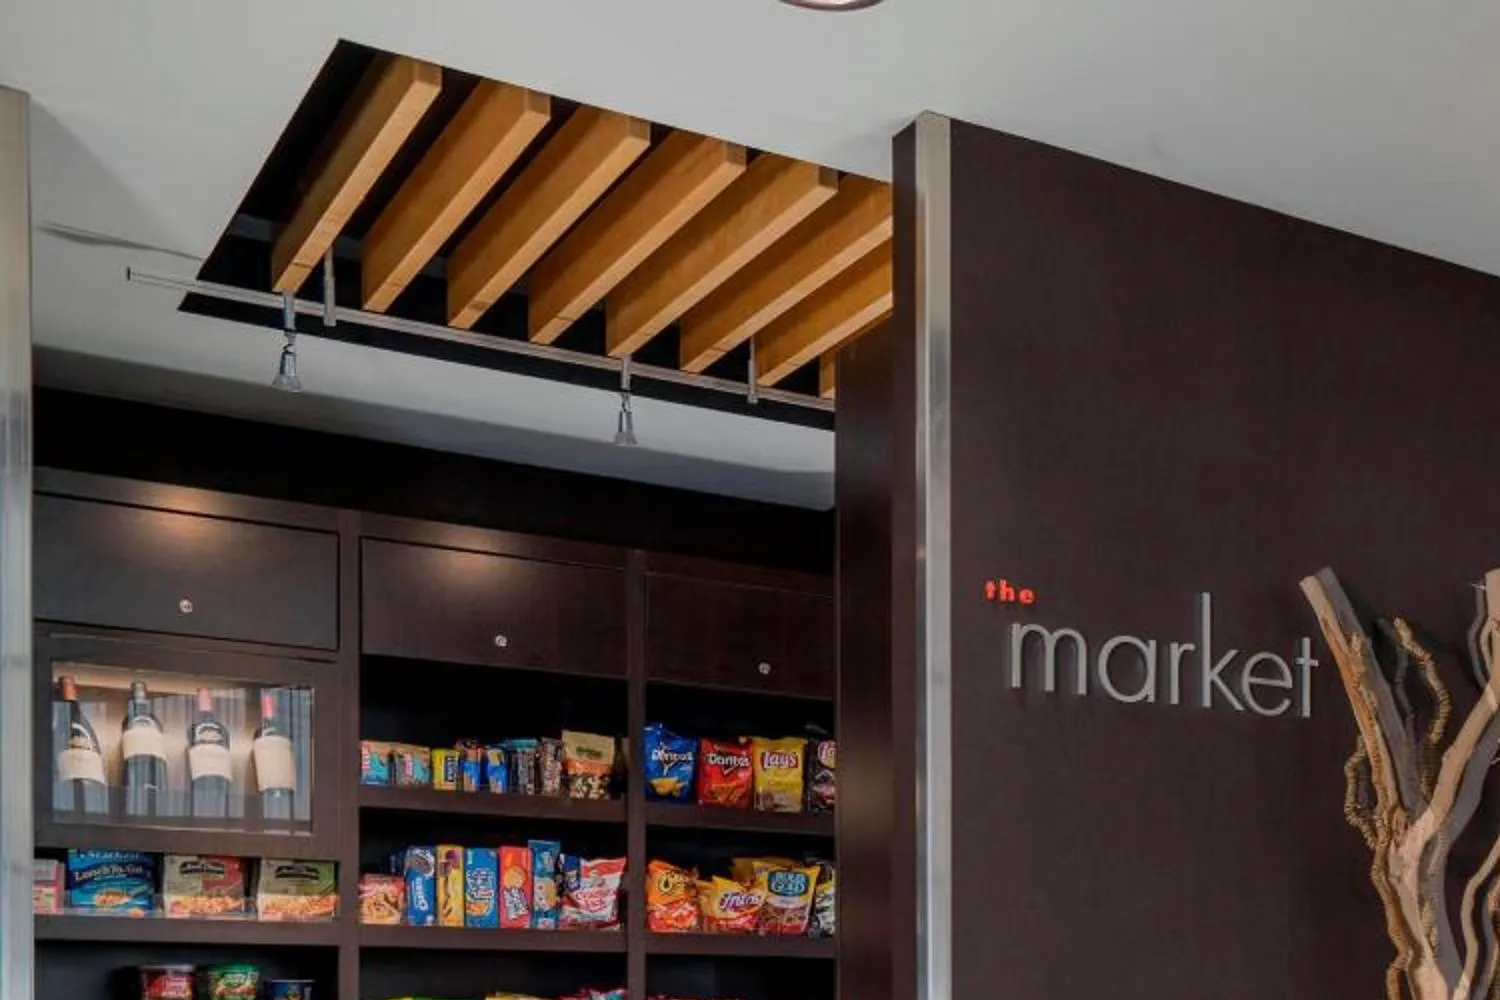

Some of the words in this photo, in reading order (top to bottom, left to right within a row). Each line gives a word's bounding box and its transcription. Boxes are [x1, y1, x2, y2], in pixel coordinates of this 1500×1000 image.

[983, 579, 1037, 606] the
[1010, 591, 1320, 719] market
[652, 749, 694, 762] Doritos
[707, 753, 750, 767] Doritos
